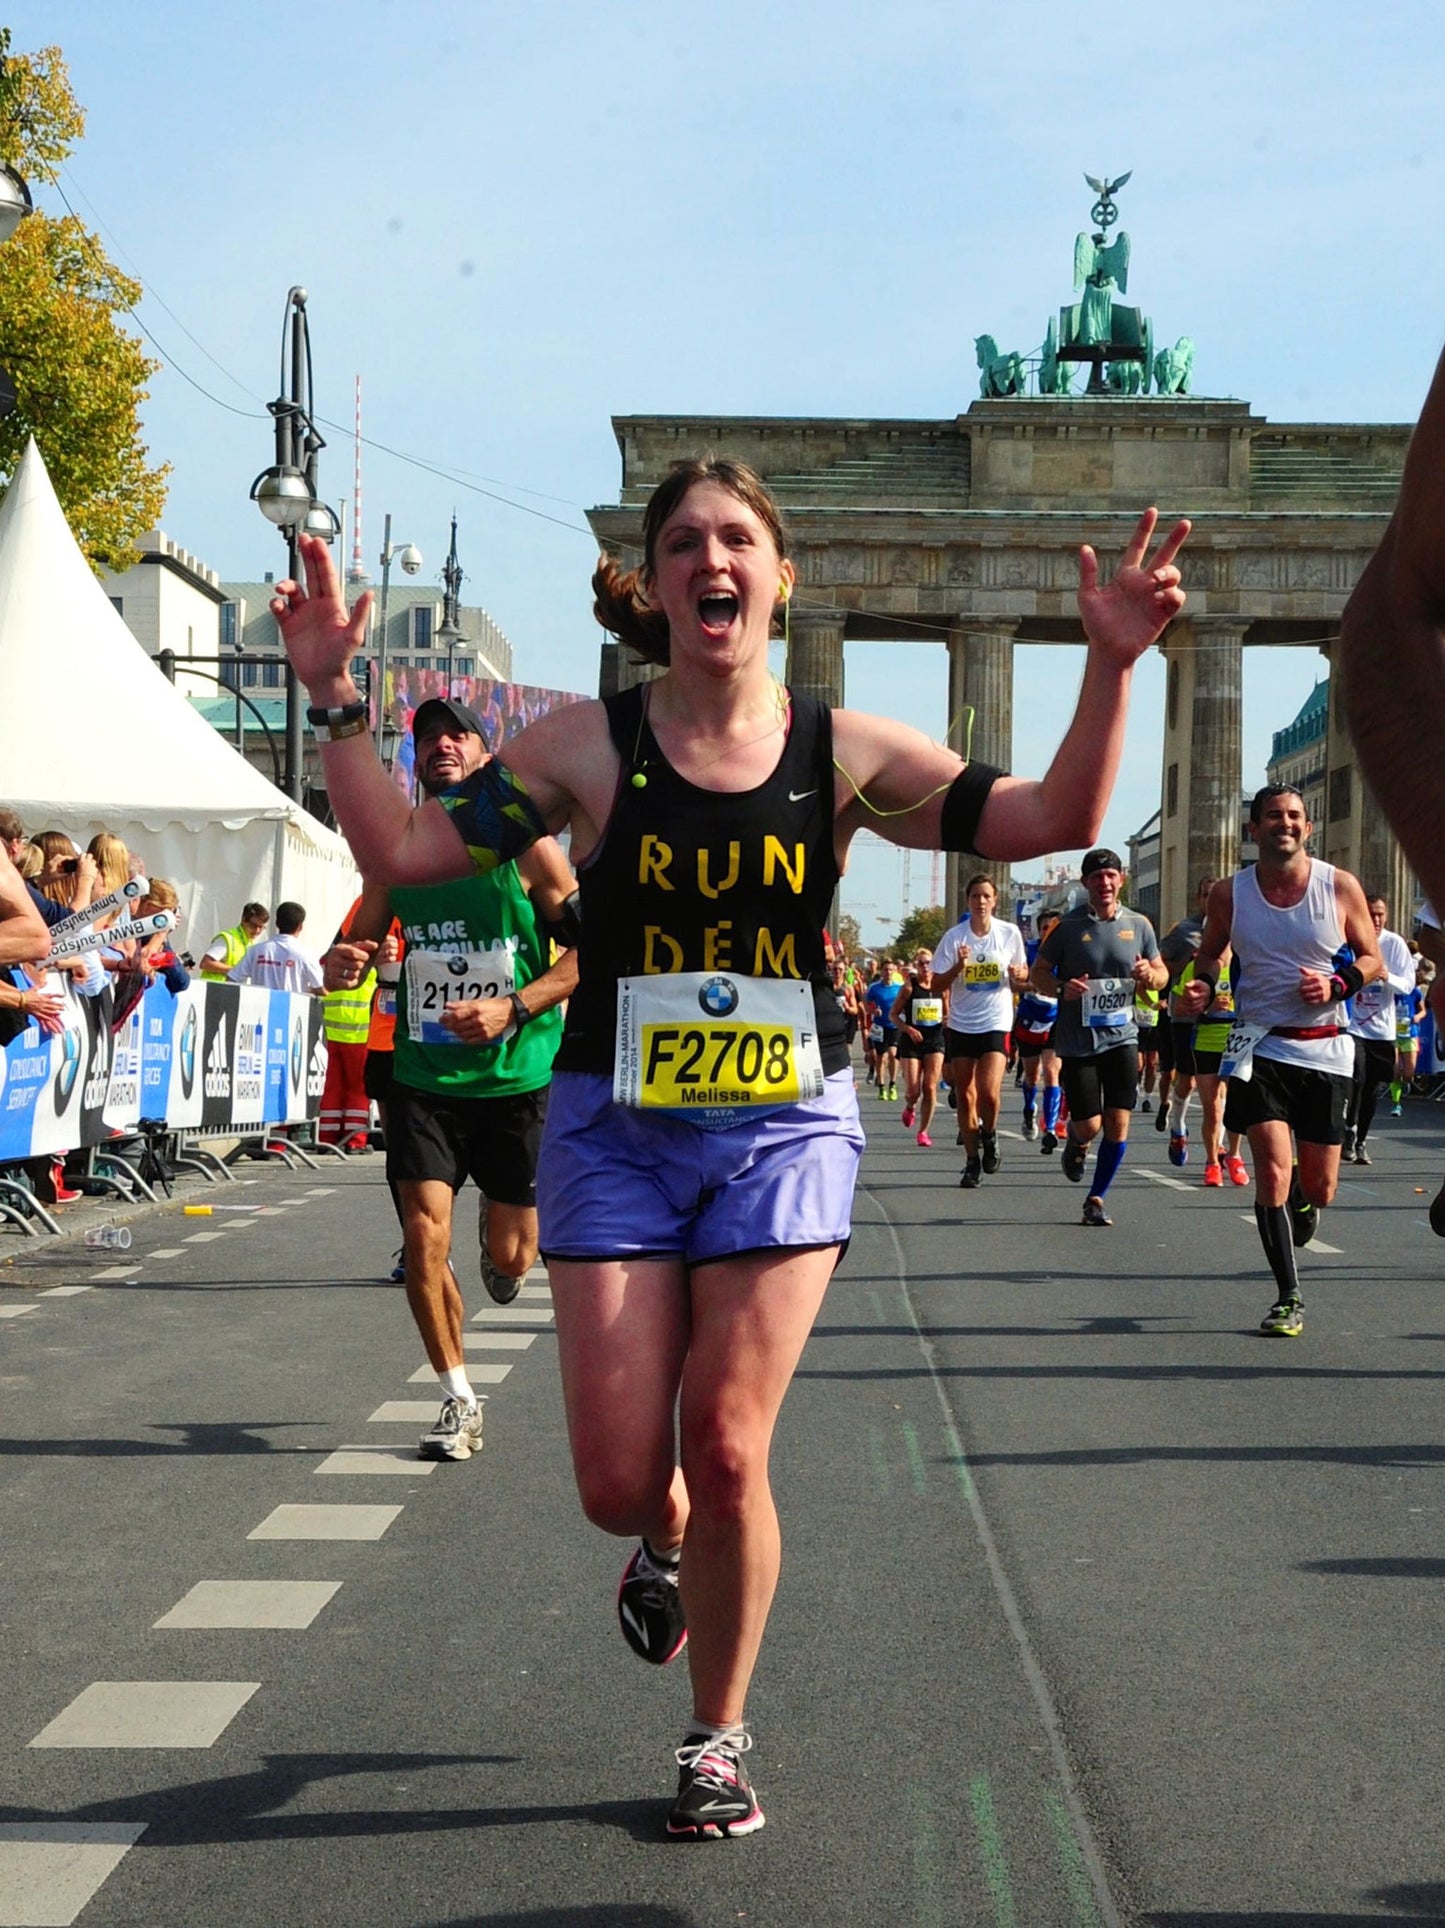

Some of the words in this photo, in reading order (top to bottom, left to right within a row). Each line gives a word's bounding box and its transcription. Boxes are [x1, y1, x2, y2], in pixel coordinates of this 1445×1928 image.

[638, 834, 805, 899] RUN
[109, 921, 145, 941] BMW
[428, 920, 468, 941] ARE
[48, 933, 106, 956] Laufspo
[643, 920, 803, 980] DEM
[965, 964, 999, 978] F1268
[504, 978, 514, 989] H
[1091, 993, 1127, 1010] 10520
[800, 1032, 812, 1049] F
[645, 1030, 790, 1085] F2708
[681, 1087, 751, 1103] Melissa
[704, 1109, 735, 1118] TATA
